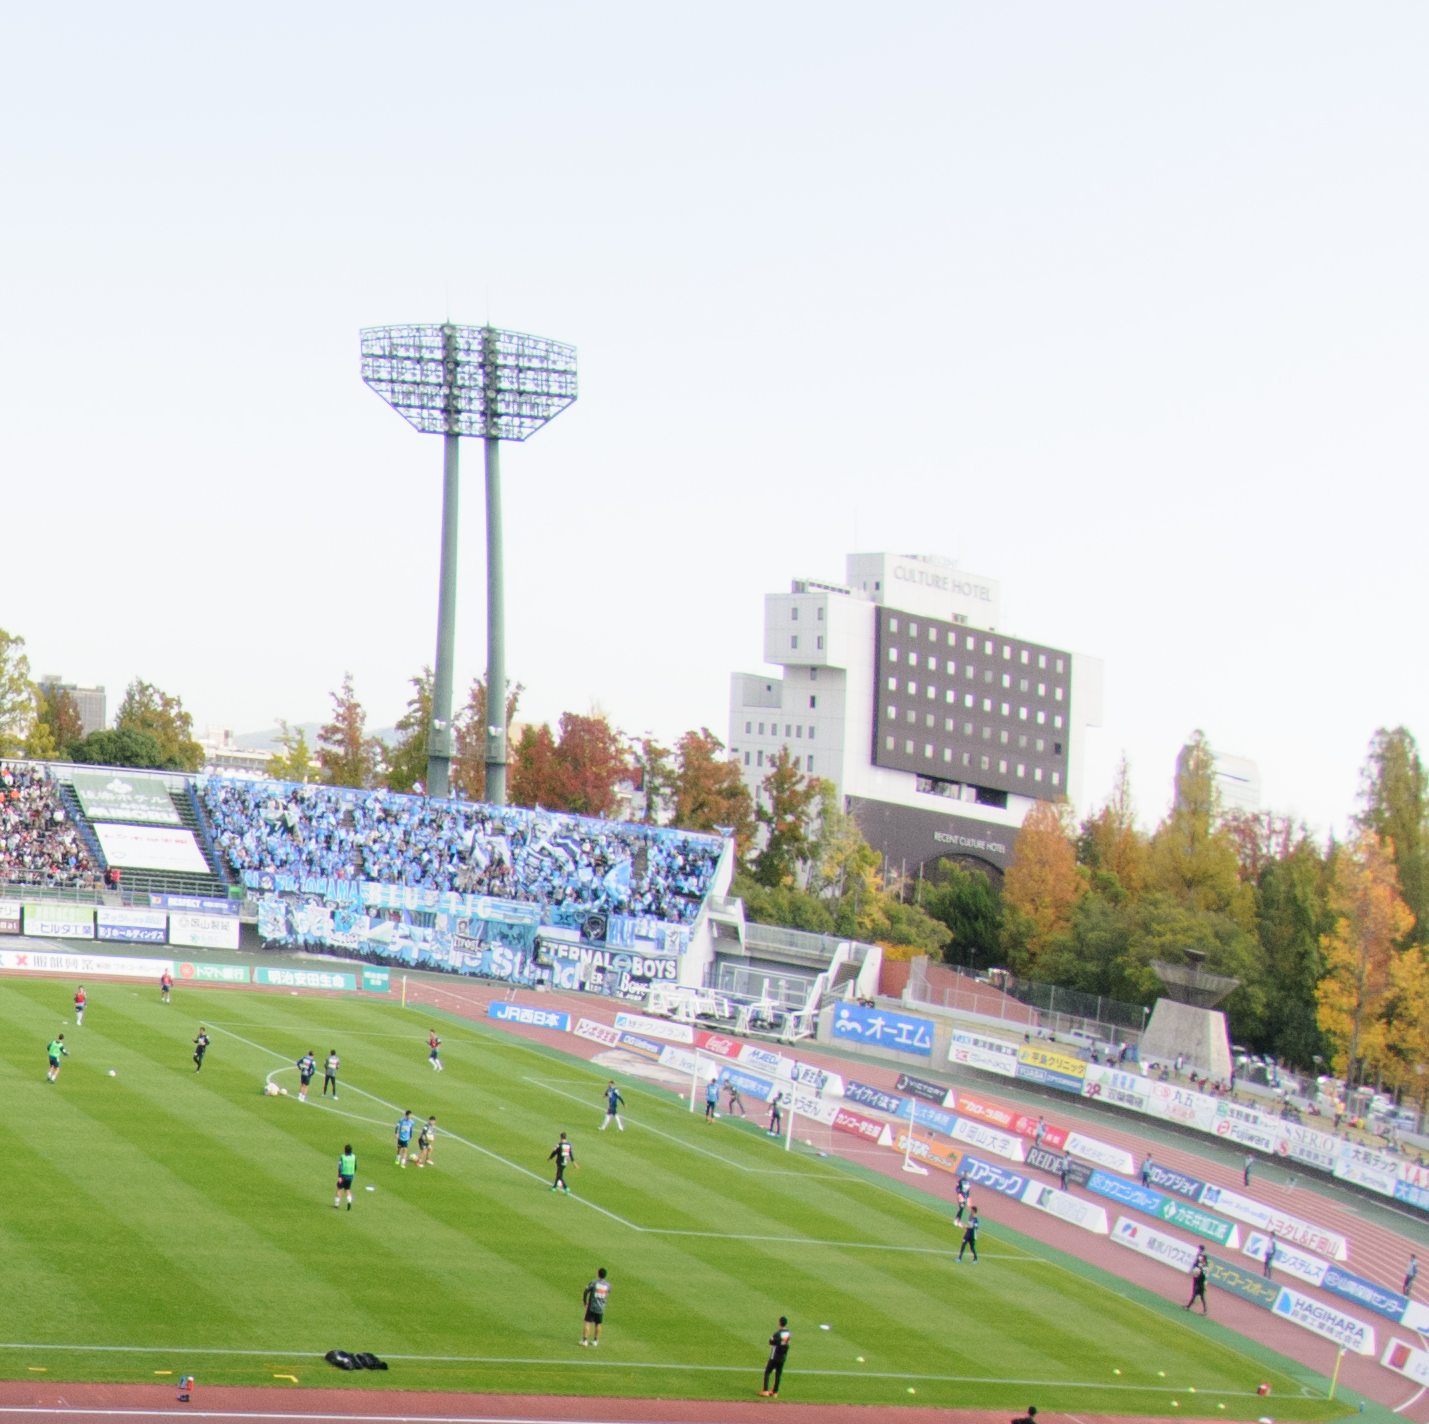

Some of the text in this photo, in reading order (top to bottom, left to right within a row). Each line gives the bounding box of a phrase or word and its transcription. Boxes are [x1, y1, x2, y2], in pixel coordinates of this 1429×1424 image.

[894, 565, 992, 602] CULTURE HOTEL
[39, 922, 93, 936] ヒルタ工業
[32, 955, 95, 971] 服部興業
[195, 965, 246, 981] トマト銀行
[632, 956, 677, 979] BOYS
[267, 969, 346, 989] 明治安田生命
[496, 1005, 561, 1027] JR西日本
[865, 1016, 932, 1049] オーエム
[1173, 1086, 1194, 1107] 丸五
[968, 1125, 1011, 1152] 岡山大学
[1229, 1119, 1271, 1149] Fujiwara
[1292, 1126, 1335, 1152] SERIO
[967, 1157, 1023, 1195] コアテック
[1265, 1213, 1338, 1257] トヨタL&F岡山
[1293, 1297, 1365, 1340] HAGIHARA
